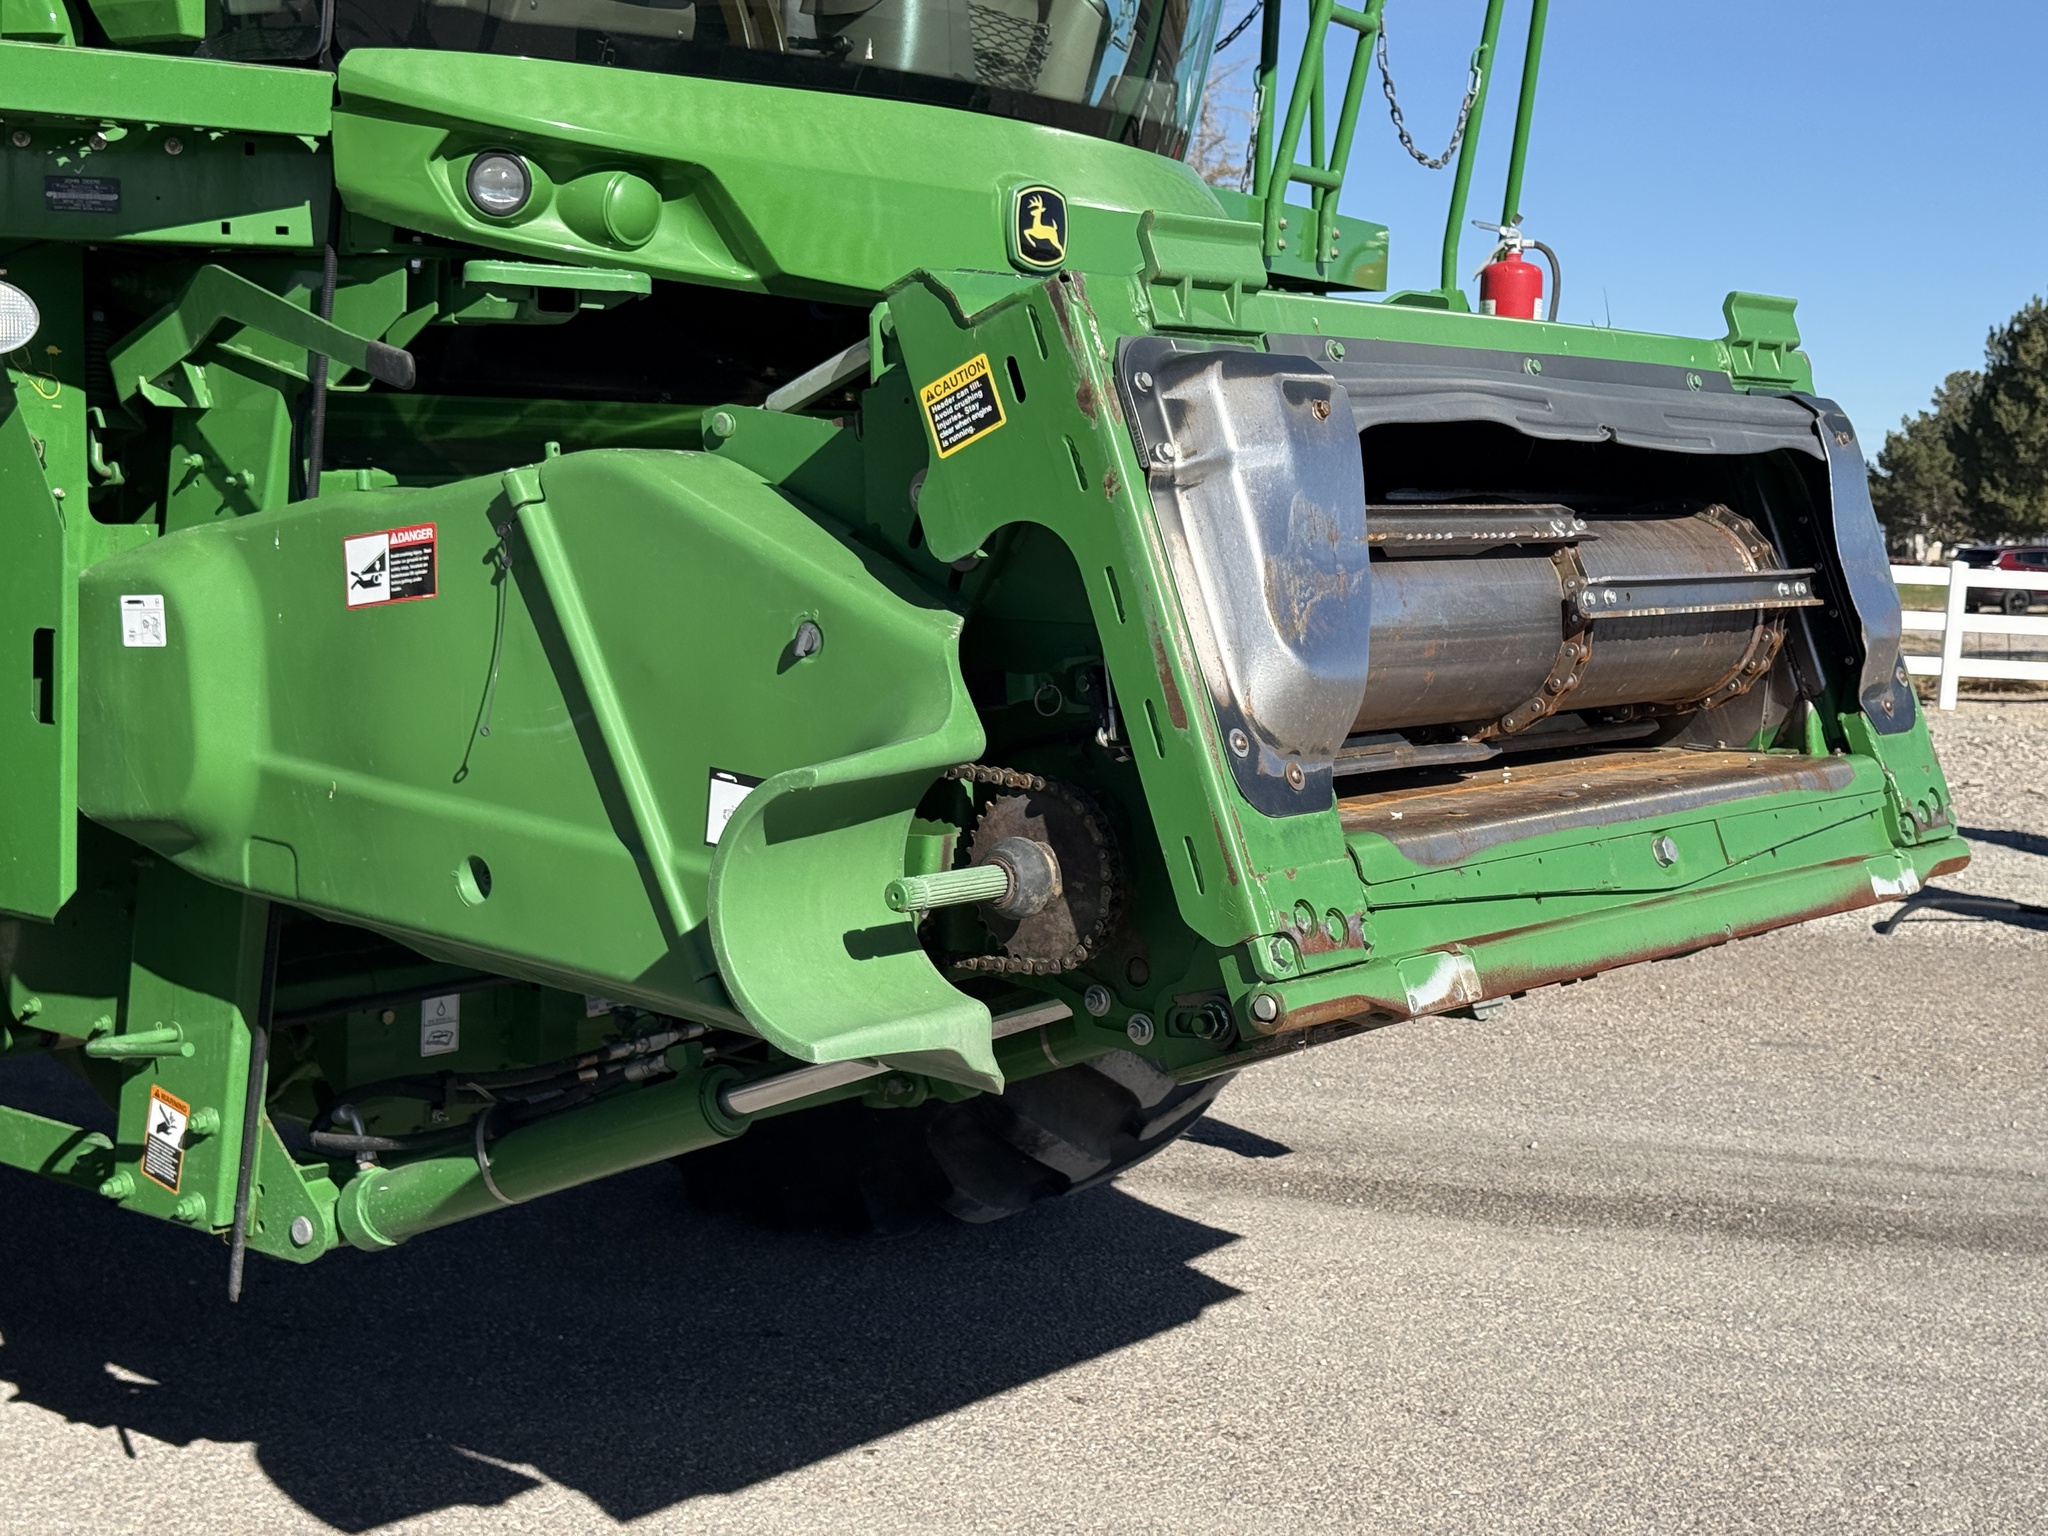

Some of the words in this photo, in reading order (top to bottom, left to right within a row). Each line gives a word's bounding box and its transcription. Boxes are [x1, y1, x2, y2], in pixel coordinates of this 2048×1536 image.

[933, 358, 986, 397] CAUTION
[931, 395, 956, 414] Header
[956, 387, 970, 399] can
[934, 405, 954, 422] Avoid
[953, 390, 984, 411] crushing
[964, 401, 980, 415] Stay
[939, 426, 955, 439] clear
[954, 416, 972, 430] when
[971, 405, 993, 420] engine
[948, 425, 976, 444] running.
[397, 527, 434, 542] DANGER
[160, 1092, 188, 1113] WARNING
